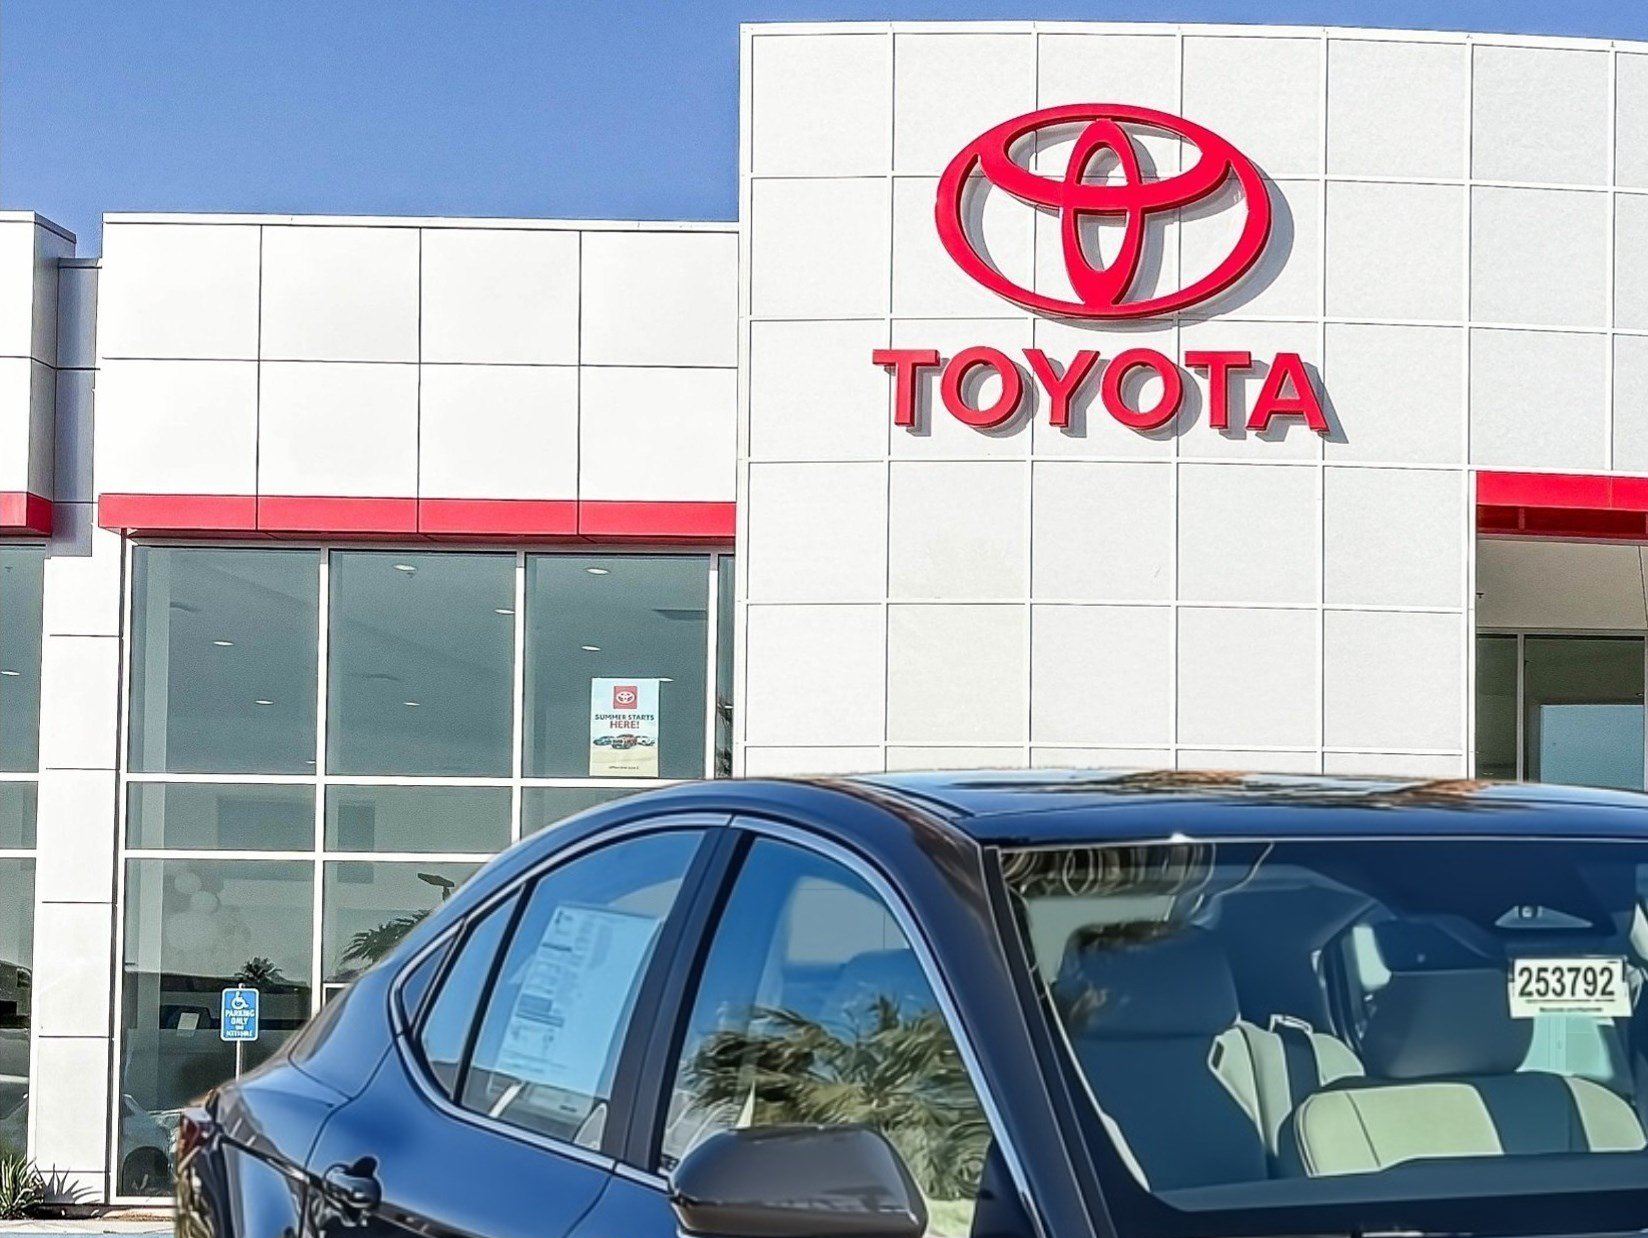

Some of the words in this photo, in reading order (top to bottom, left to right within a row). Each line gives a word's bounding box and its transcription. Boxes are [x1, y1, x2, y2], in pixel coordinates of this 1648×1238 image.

[872, 345, 1330, 433] TOYOTA
[610, 721, 640, 729] HERE!
[1518, 966, 1615, 998] 253792
